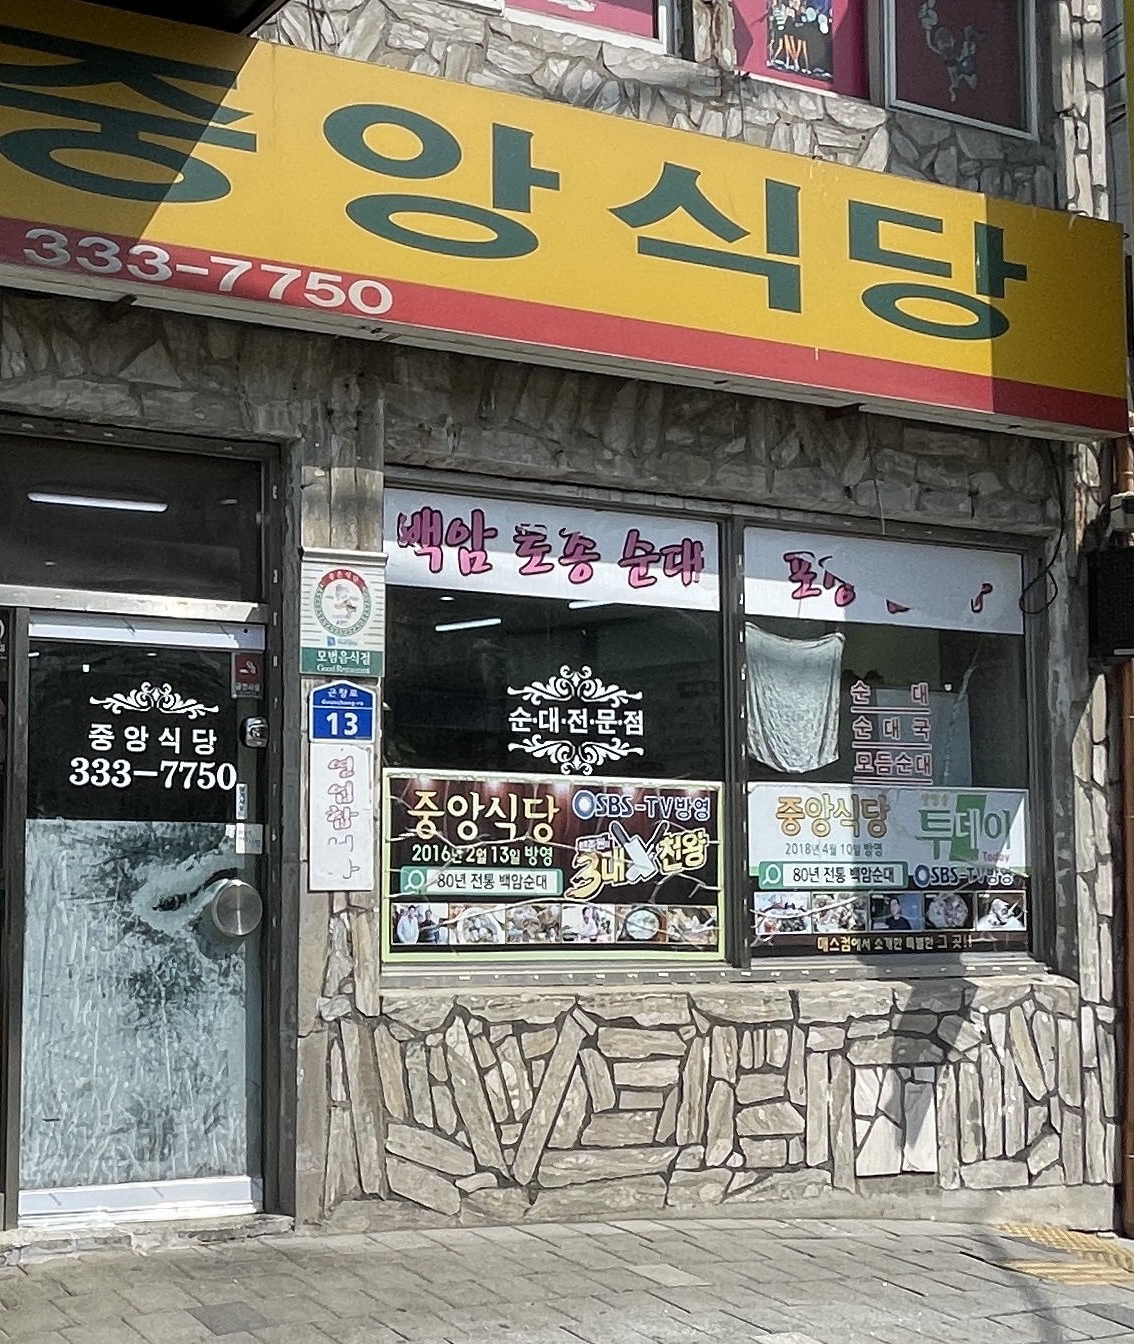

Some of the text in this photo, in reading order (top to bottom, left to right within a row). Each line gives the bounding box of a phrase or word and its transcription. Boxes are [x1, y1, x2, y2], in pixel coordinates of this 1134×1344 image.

[23, 228, 394, 316] 333-7750
[397, 506, 705, 589] 백암 토종 순대
[316, 649, 371, 666] 모범음식점
[326, 712, 358, 736] 13
[852, 715, 932, 742] 순대국
[88, 723, 218, 756] 중앙식당
[68, 757, 238, 791] 333-7750
[854, 751, 933, 777] 모듬순대
[407, 790, 561, 844] 중앙식당
[776, 792, 892, 839] 중앙식당
[914, 808, 1012, 861] 투데이
[411, 844, 554, 867] 2016년 2월 13일 방영
[657, 829, 708, 874] 천왕
[785, 842, 884, 857] 2018년 4월 10일 방영
[982, 851, 1011, 863] Today
[437, 872, 548, 891] 80년 전통 백암순대
[793, 866, 896, 884] 80년 전통 백암순대
[937, 934, 948, 949] 그
